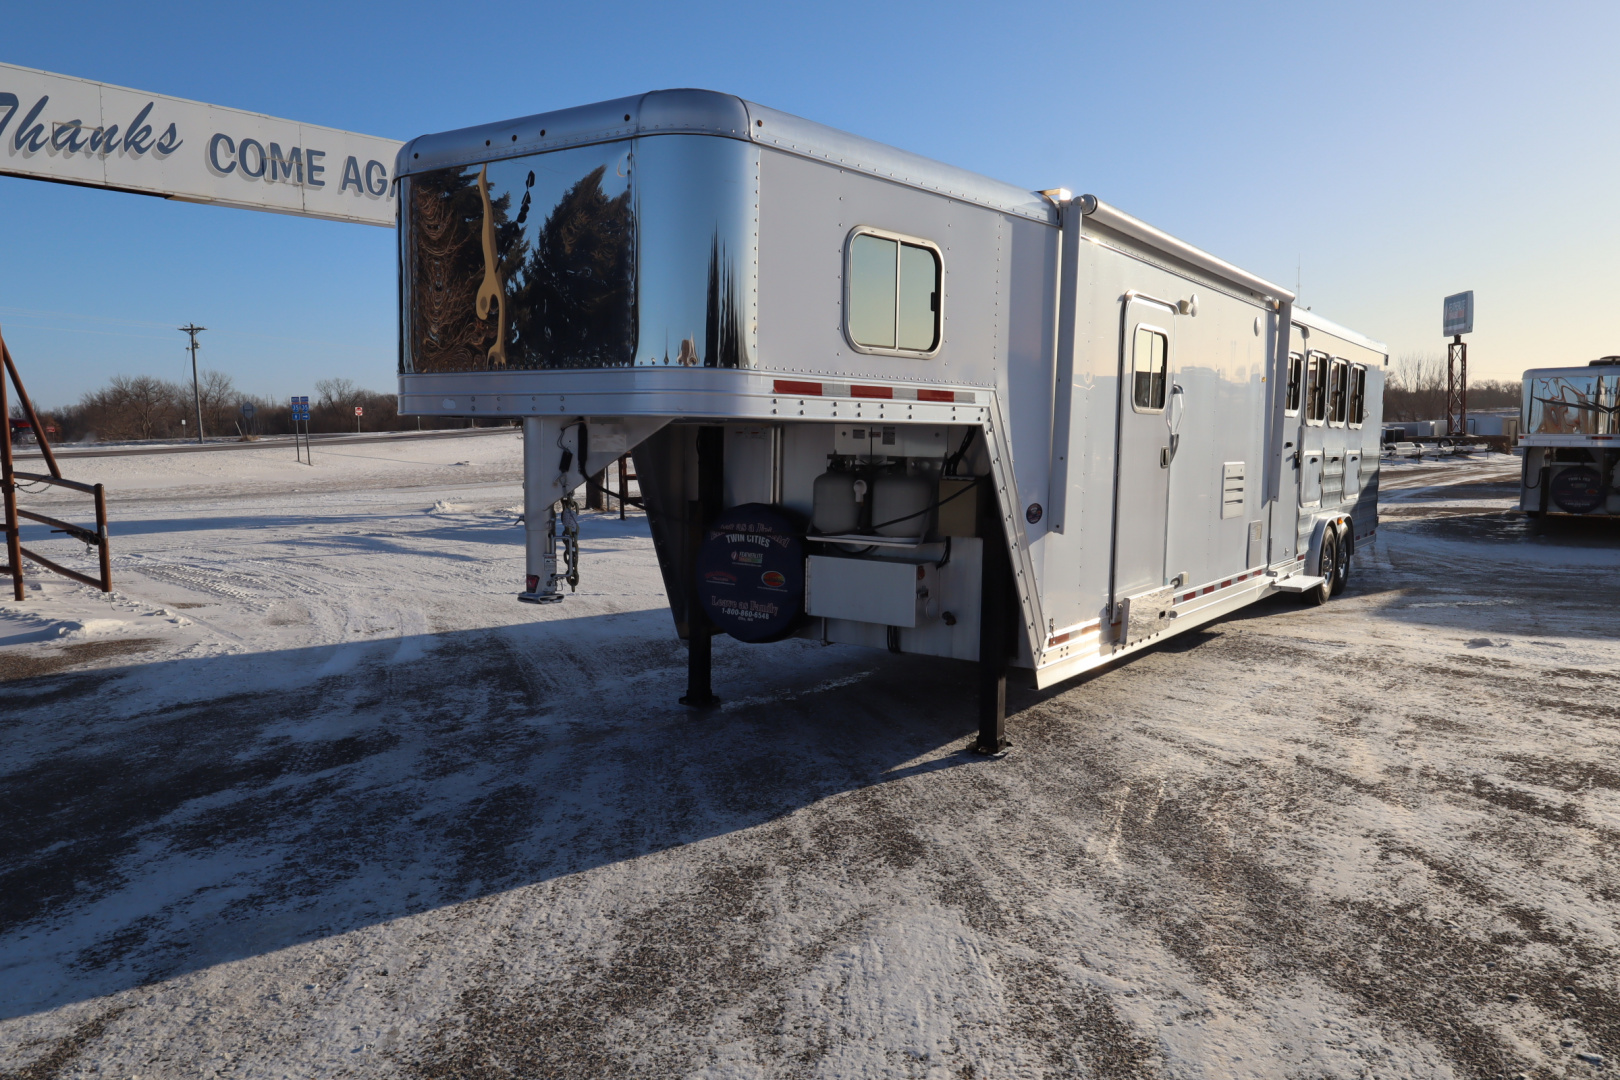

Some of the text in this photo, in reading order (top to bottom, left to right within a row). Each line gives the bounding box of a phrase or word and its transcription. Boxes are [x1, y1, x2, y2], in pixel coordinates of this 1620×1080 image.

[208, 132, 327, 187] COME
[340, 154, 396, 198] AG
[725, 533, 771, 548] TWIN CITIES
